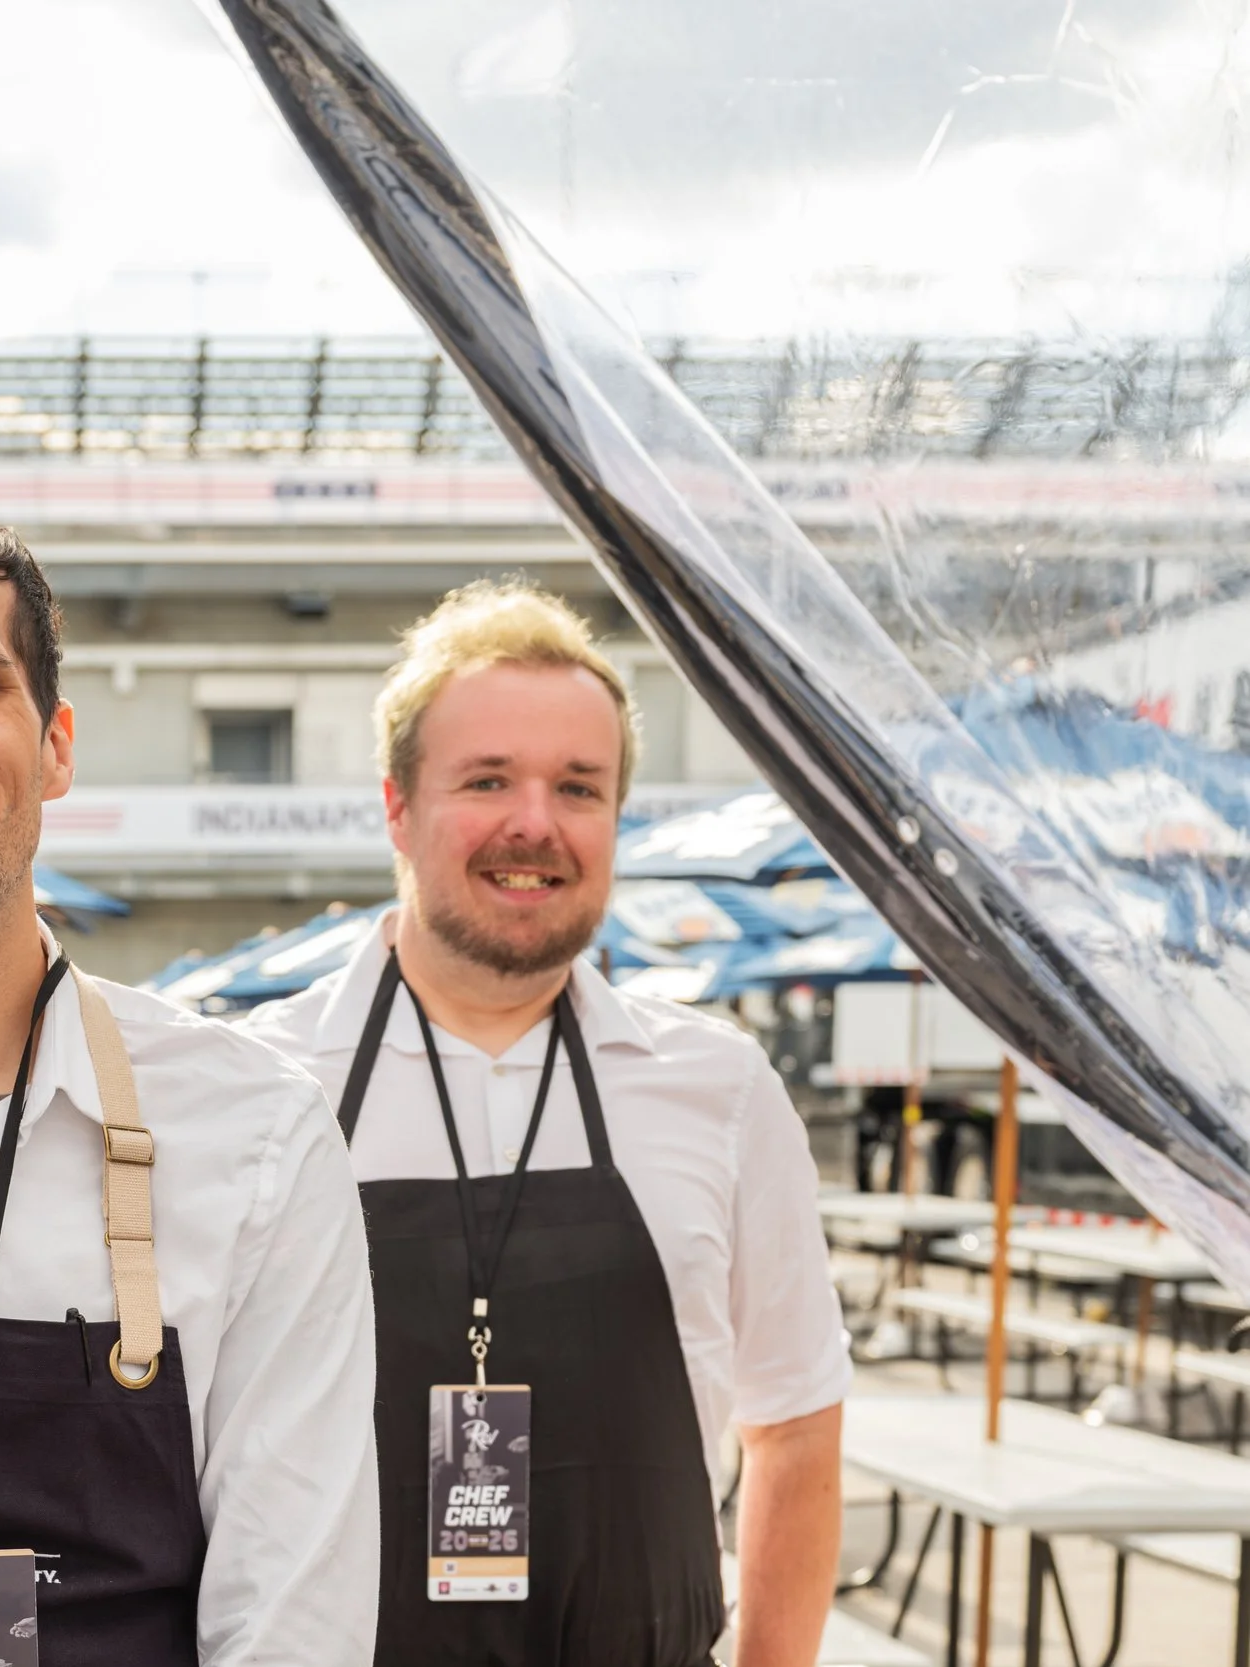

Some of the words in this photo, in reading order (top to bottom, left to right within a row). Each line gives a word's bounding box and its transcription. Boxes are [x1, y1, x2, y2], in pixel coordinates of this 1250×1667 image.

[192, 804, 386, 834] INDIANAPO
[448, 1485, 510, 1505] CHEF
[444, 1506, 513, 1526] CREW
[35, 1570, 61, 1583] TY.
